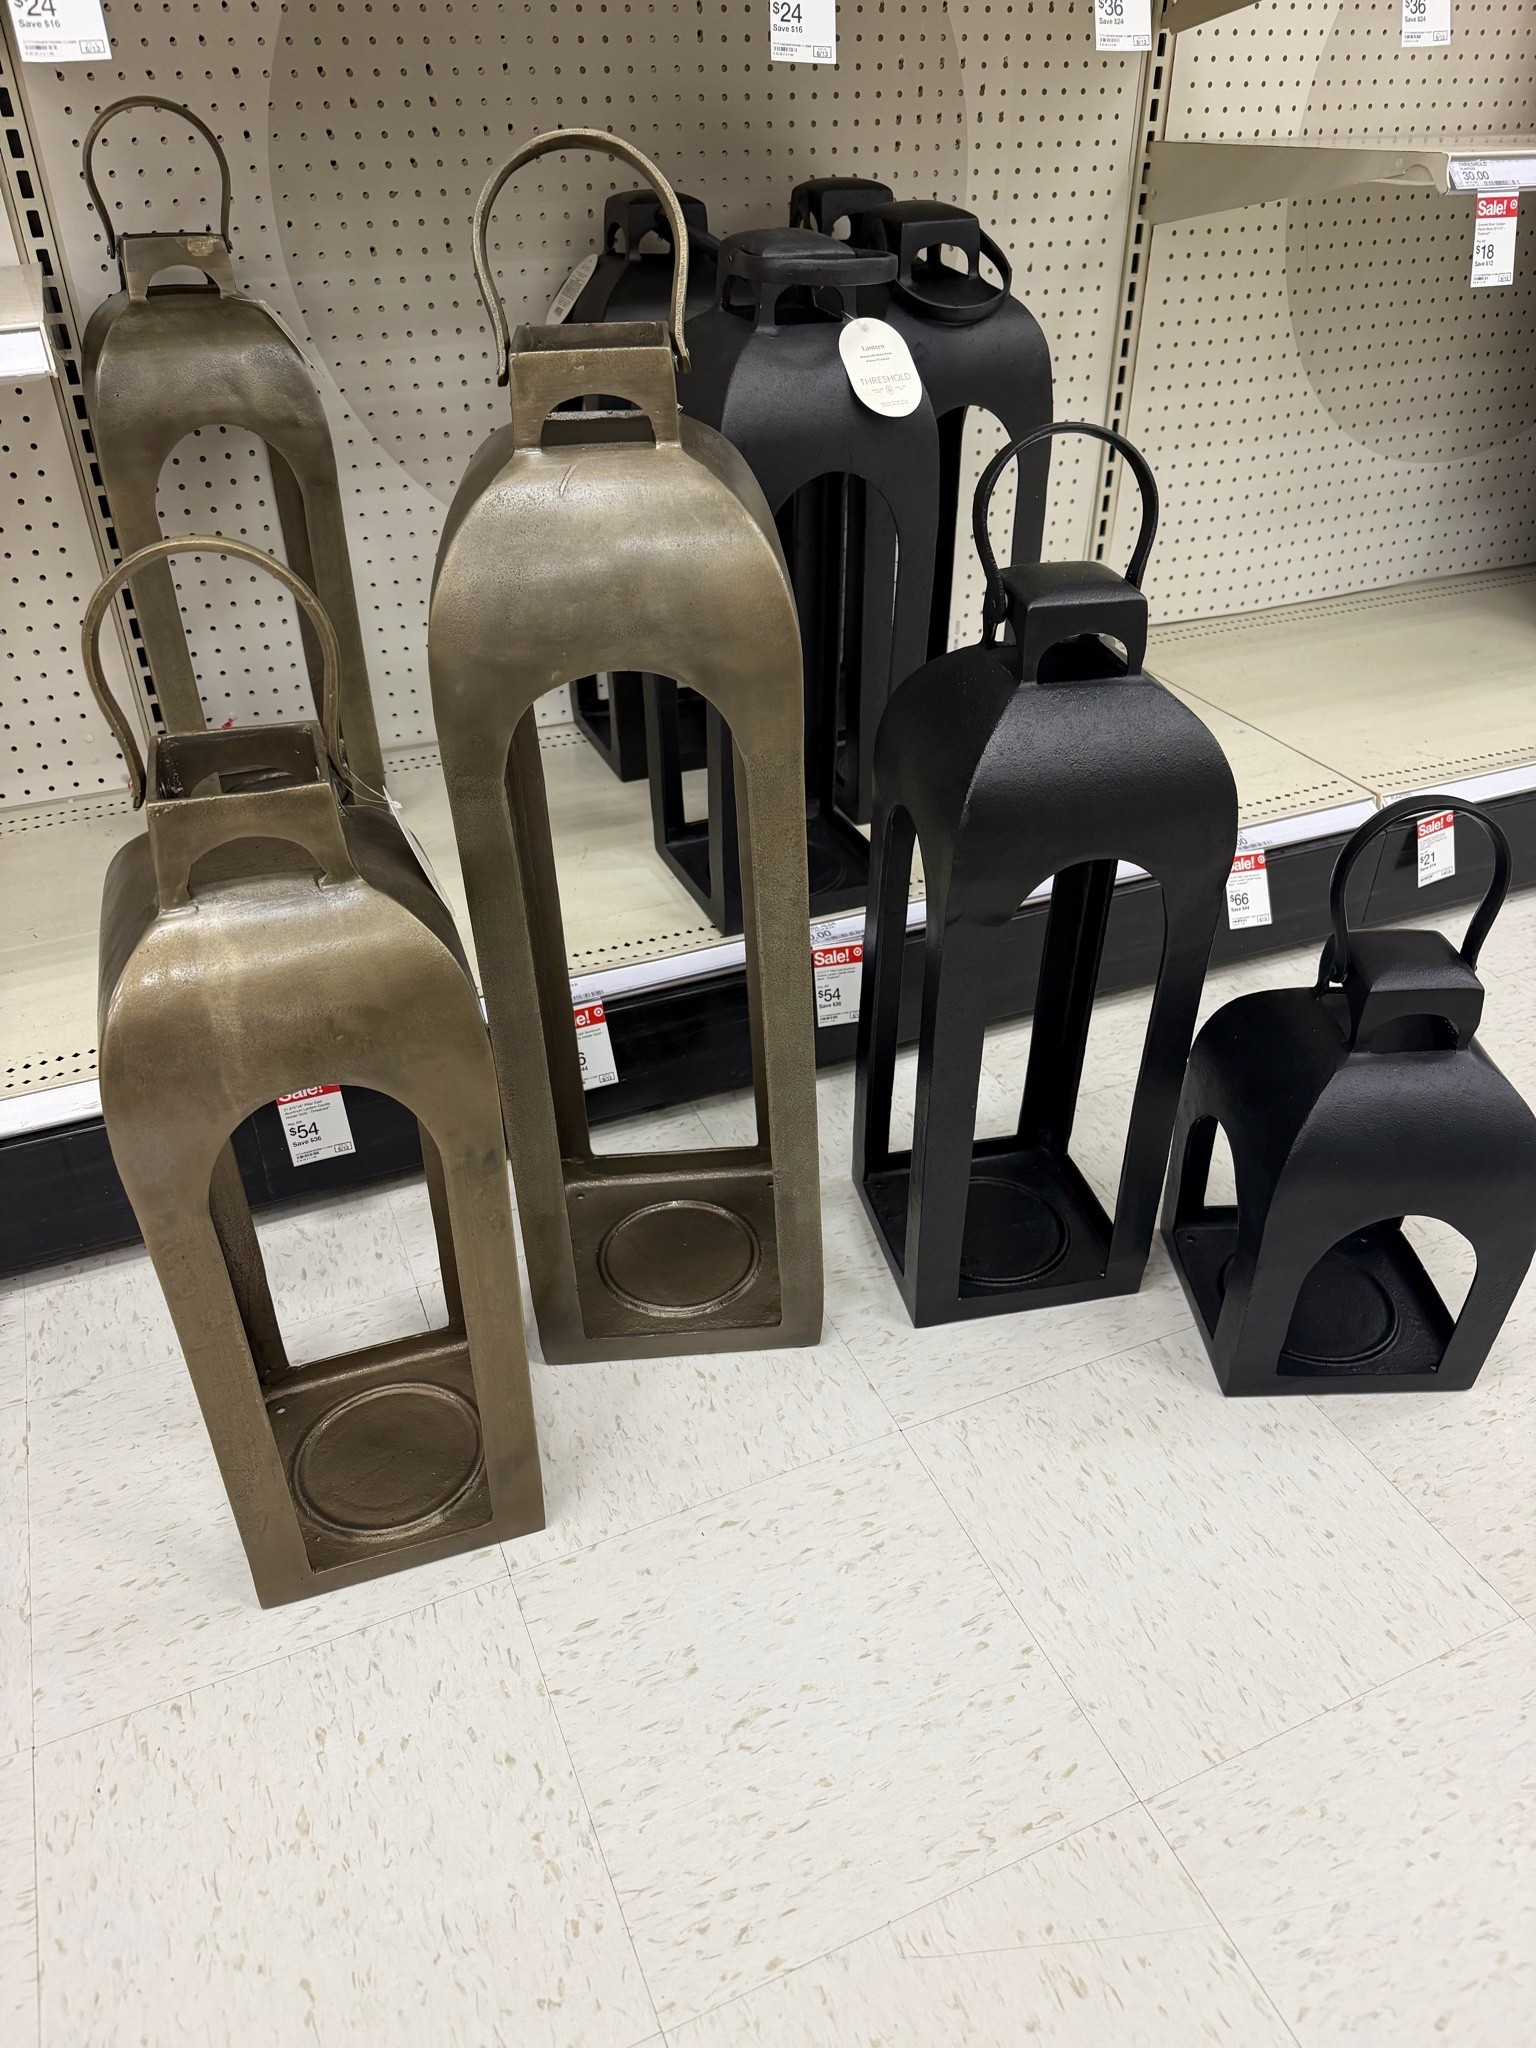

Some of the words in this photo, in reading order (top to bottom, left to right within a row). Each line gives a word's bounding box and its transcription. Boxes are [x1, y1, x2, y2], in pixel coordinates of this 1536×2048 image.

[13, 0, 56, 16] $24
[772, 1, 802, 23] $24
[1098, 0, 1123, 16] $36
[1405, 0, 1426, 14] $36
[18, 19, 42, 28] Save
[773, 24, 789, 32] Save
[1462, 170, 1490, 181] 30.00
[1478, 199, 1508, 216] Sale!
[1475, 244, 1494, 260] $18
[861, 344, 885, 352] Lantern
[860, 372, 911, 386] THRESHOLD
[1418, 817, 1444, 836] Sale!
[1231, 856, 1256, 872] ale!
[1420, 851, 1435, 866] $21
[1230, 892, 1249, 906] $66
[814, 948, 850, 966] Sale!
[818, 987, 841, 1002] $54
[289, 1121, 320, 1139] $54
[292, 1140, 309, 1148] Save
